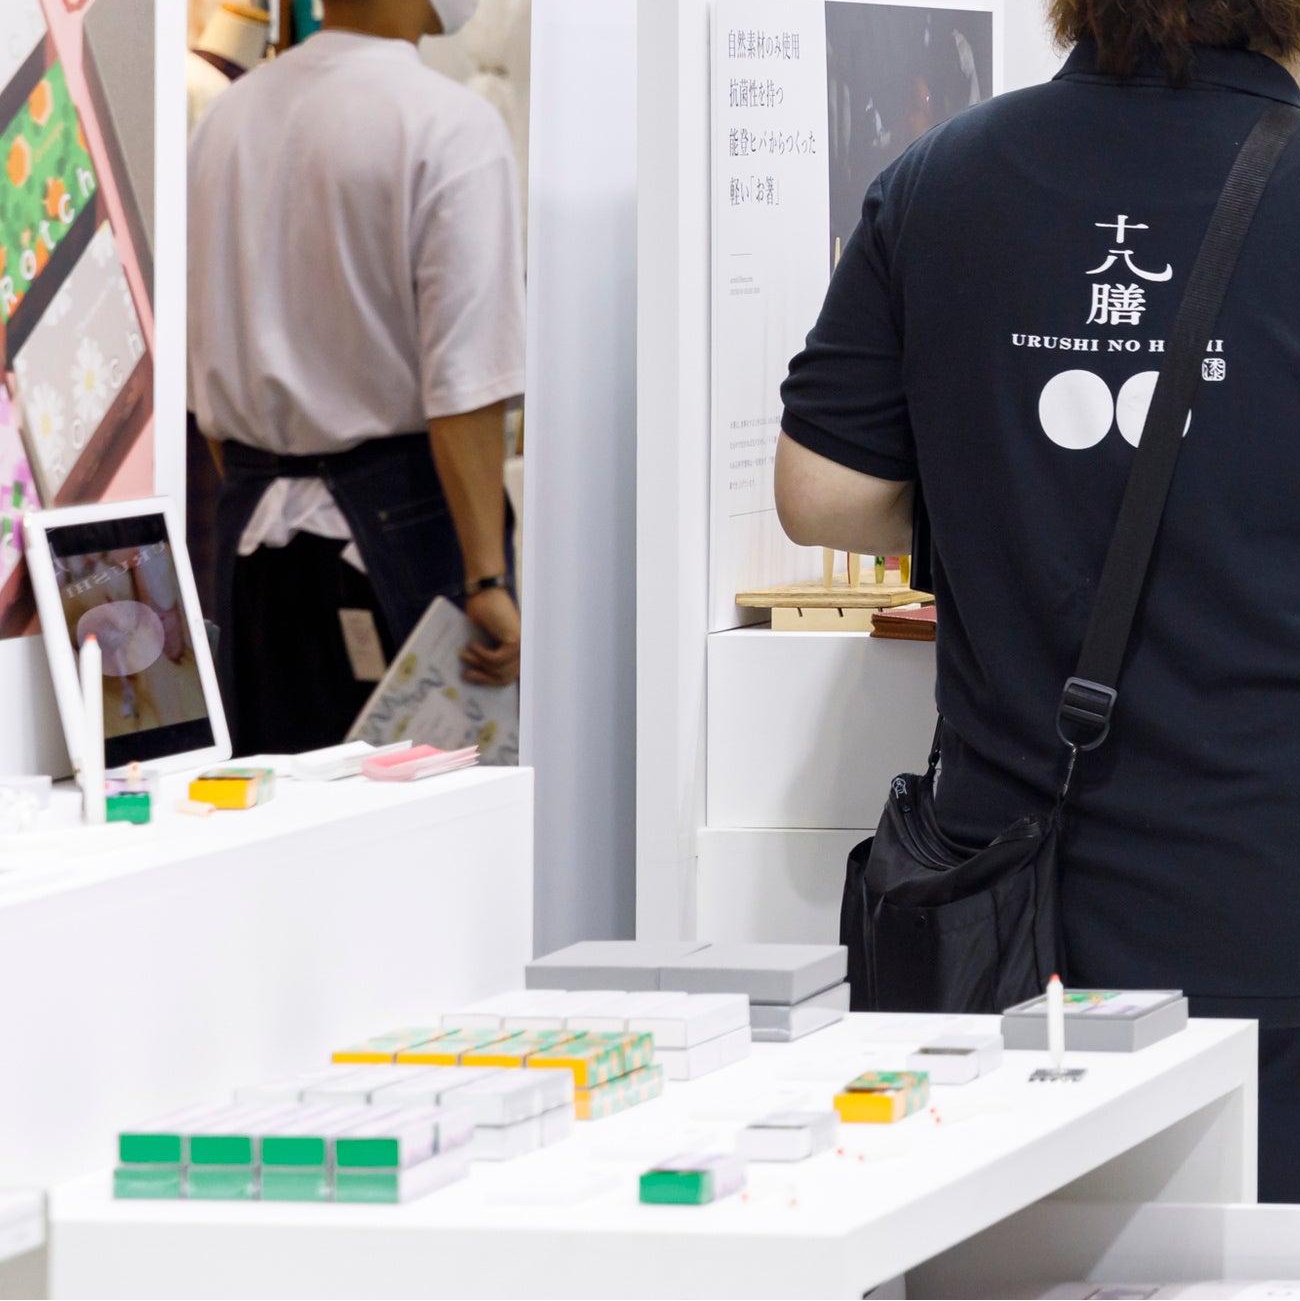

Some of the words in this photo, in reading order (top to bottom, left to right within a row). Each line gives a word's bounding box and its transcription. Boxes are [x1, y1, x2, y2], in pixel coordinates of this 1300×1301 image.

[727, 30, 800, 61] 自然素材のみ使用
[729, 78, 784, 108] 抗菌性を持つ
[729, 128, 817, 158] 能登ヒバからつくった
[730, 175, 780, 207] 軽い「お箸」
[1011, 333, 1099, 352] URUSHI
[1107, 339, 1141, 352] NO
